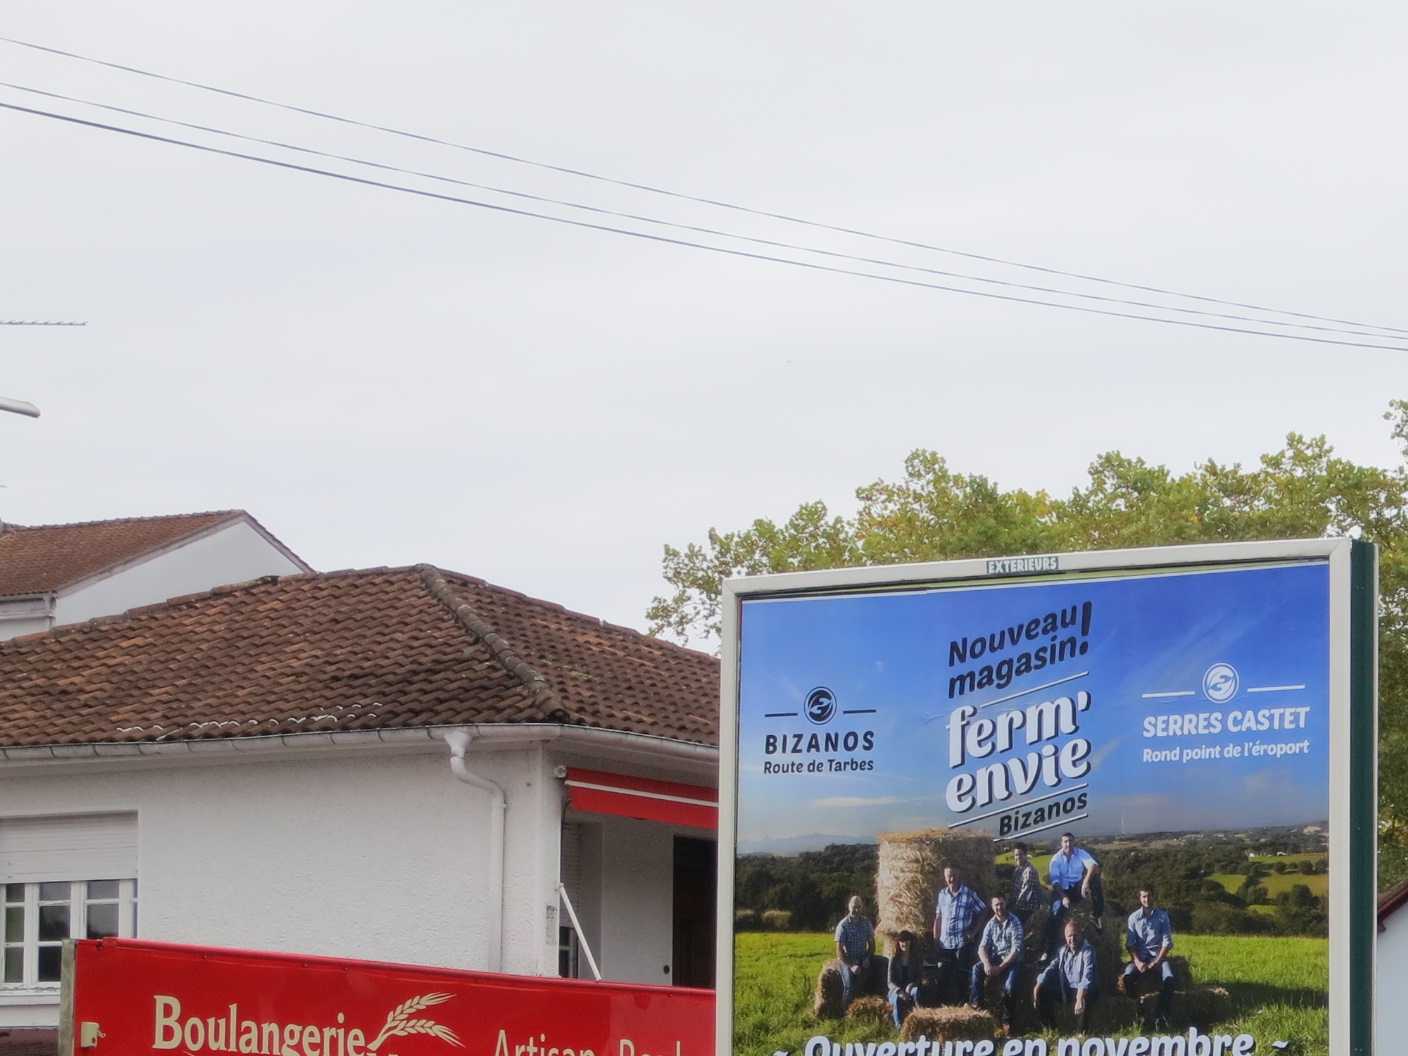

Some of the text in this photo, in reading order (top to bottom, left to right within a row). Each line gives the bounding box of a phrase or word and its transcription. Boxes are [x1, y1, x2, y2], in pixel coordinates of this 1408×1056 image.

[988, 557, 1057, 573] EXTERIEURS
[948, 604, 1078, 667] Nouveau
[1142, 706, 1311, 738] SERRES CASTET
[764, 730, 875, 755] BIZANOS
[1142, 746, 1180, 763] Rond
[1183, 744, 1221, 763] point
[1223, 743, 1241, 758] de
[763, 758, 875, 774] Route de Tarbes
[946, 738, 1092, 813] envie
[1000, 792, 1088, 836] Bizanos
